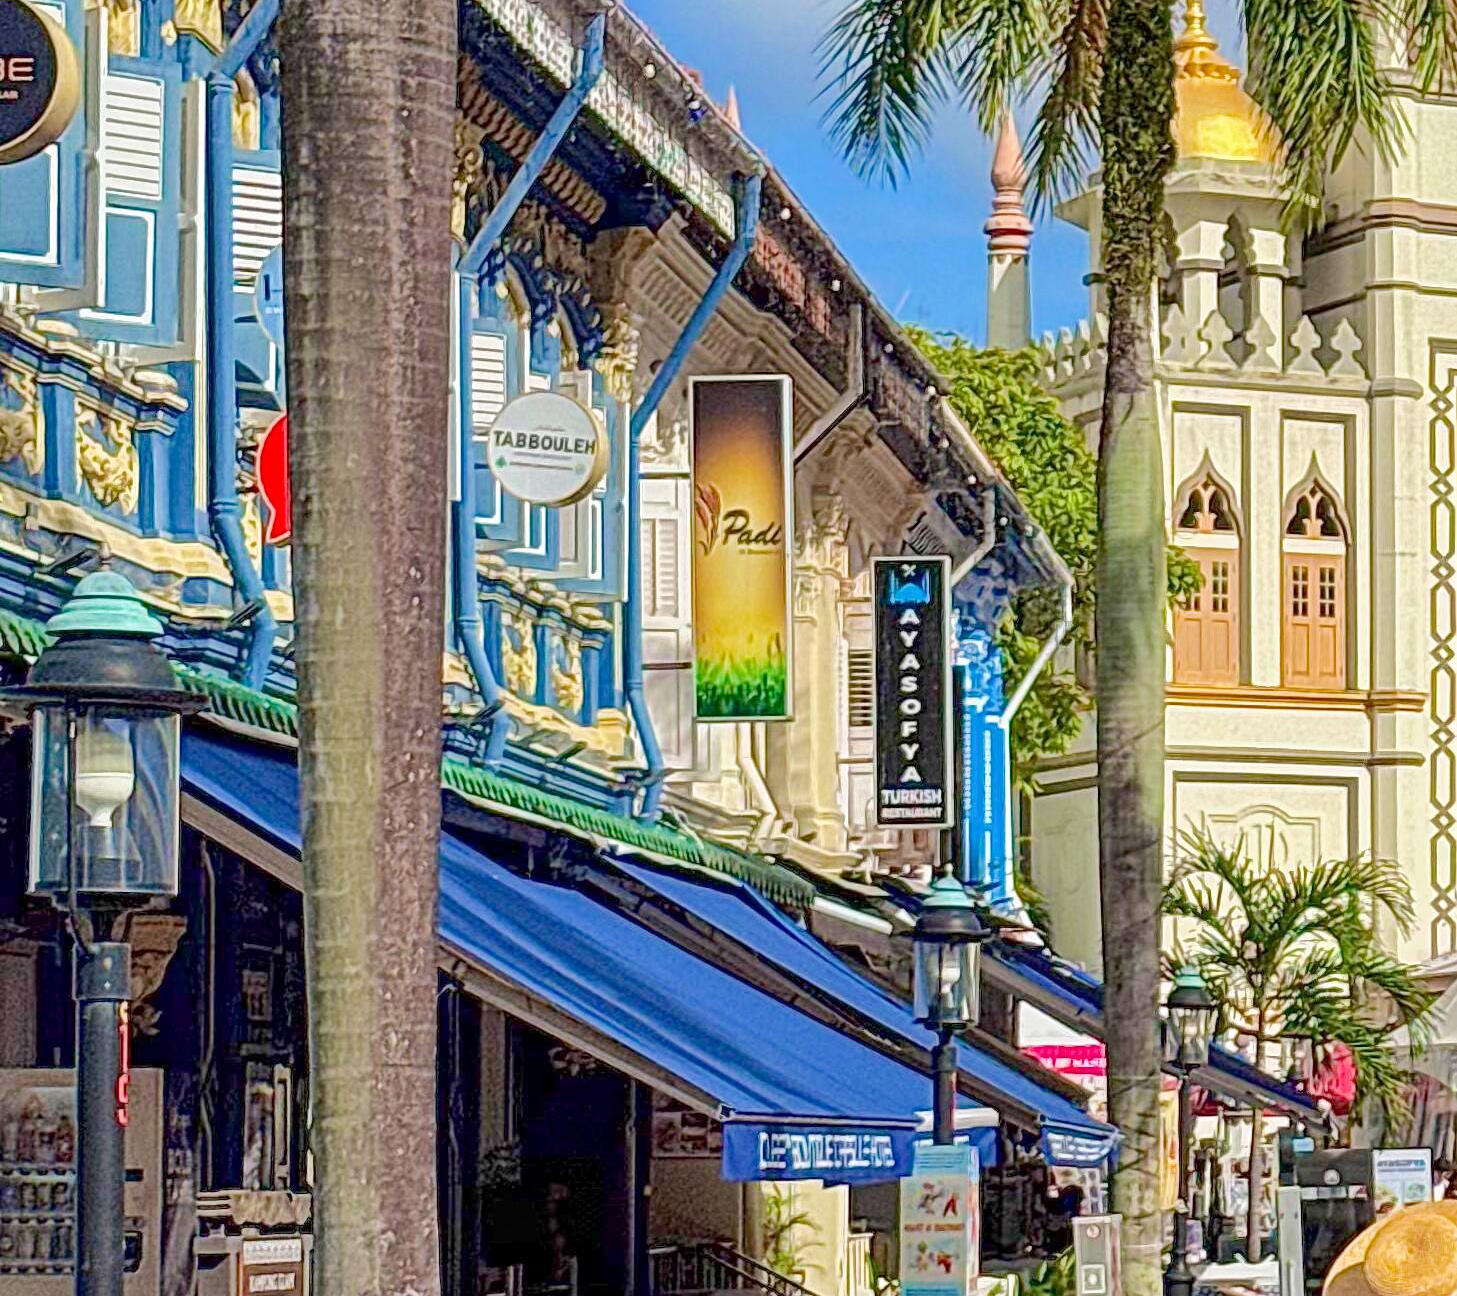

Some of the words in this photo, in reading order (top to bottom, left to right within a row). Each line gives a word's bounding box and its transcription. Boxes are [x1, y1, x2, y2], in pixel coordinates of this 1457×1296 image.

[493, 430, 596, 454] TABBOULEH
[900, 608, 922, 783] AYASOFYA
[880, 788, 942, 805] TURKISH
